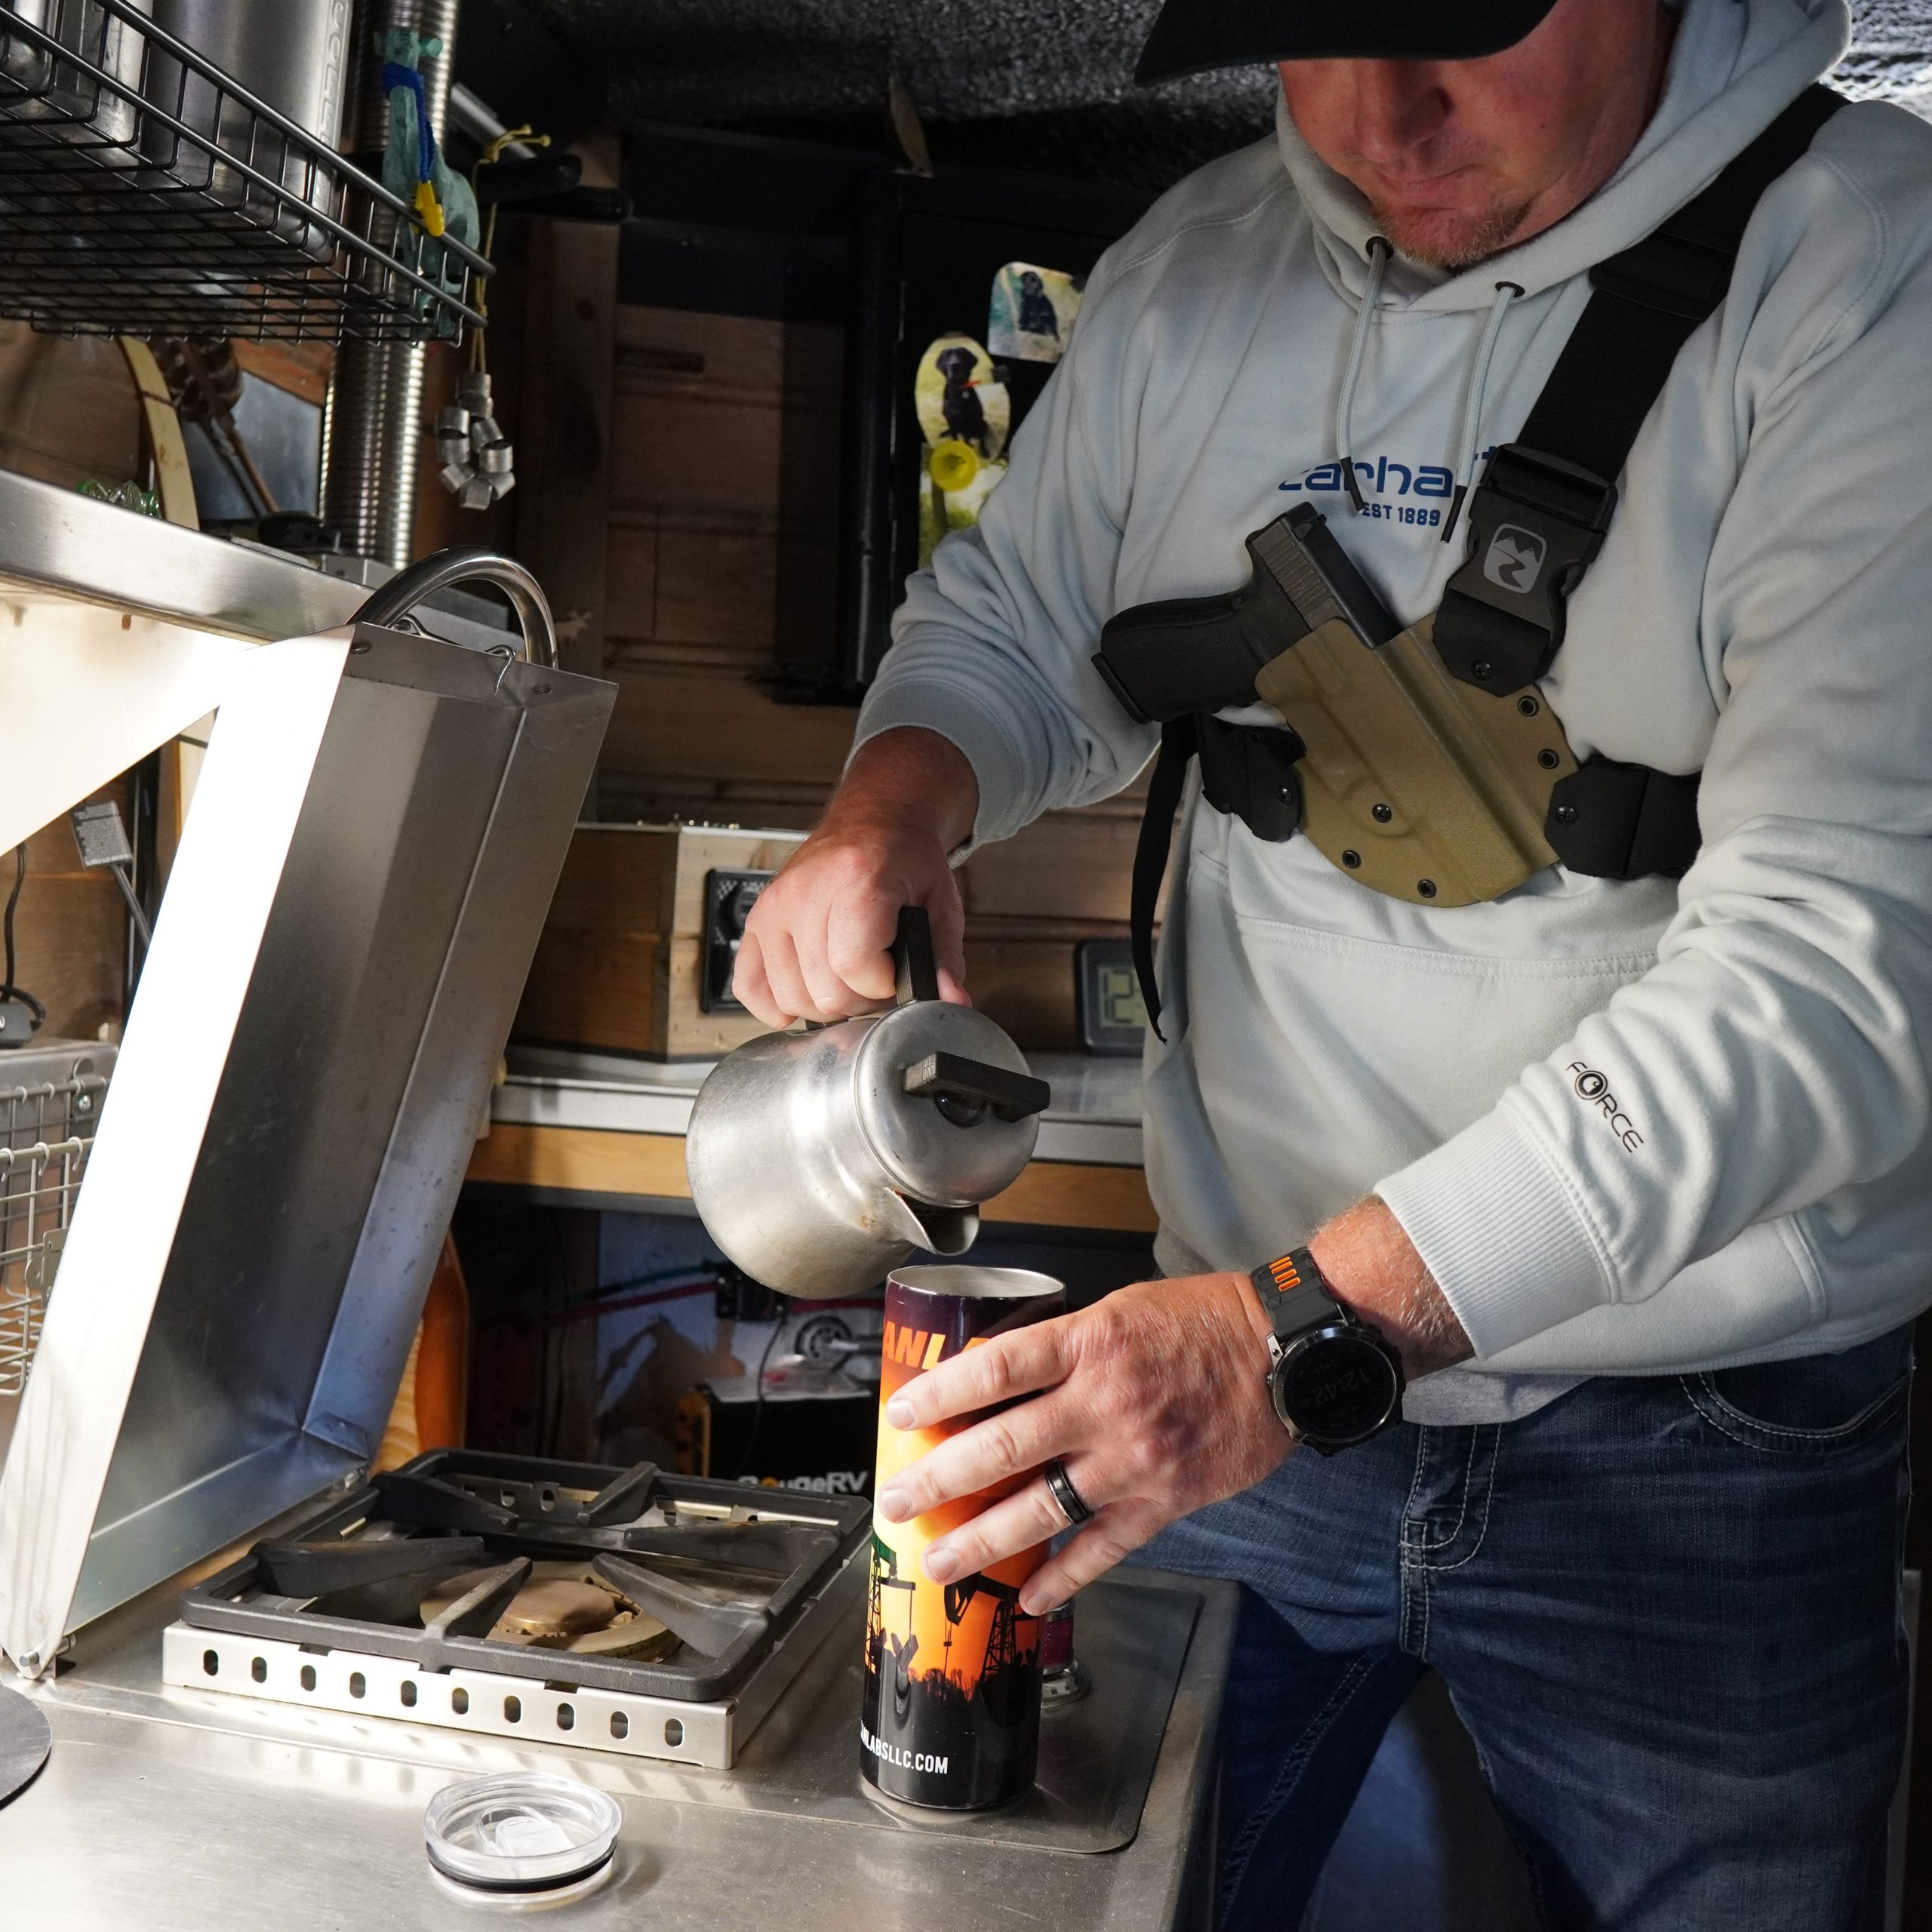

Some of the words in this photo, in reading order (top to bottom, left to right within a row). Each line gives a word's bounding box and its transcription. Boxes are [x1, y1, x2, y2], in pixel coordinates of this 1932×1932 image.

[1362, 502, 1393, 520] EST
[1398, 506, 1441, 528] 1889
[1565, 1061, 1644, 1154] FORCE
[1310, 1367, 1370, 1405] 12:42
